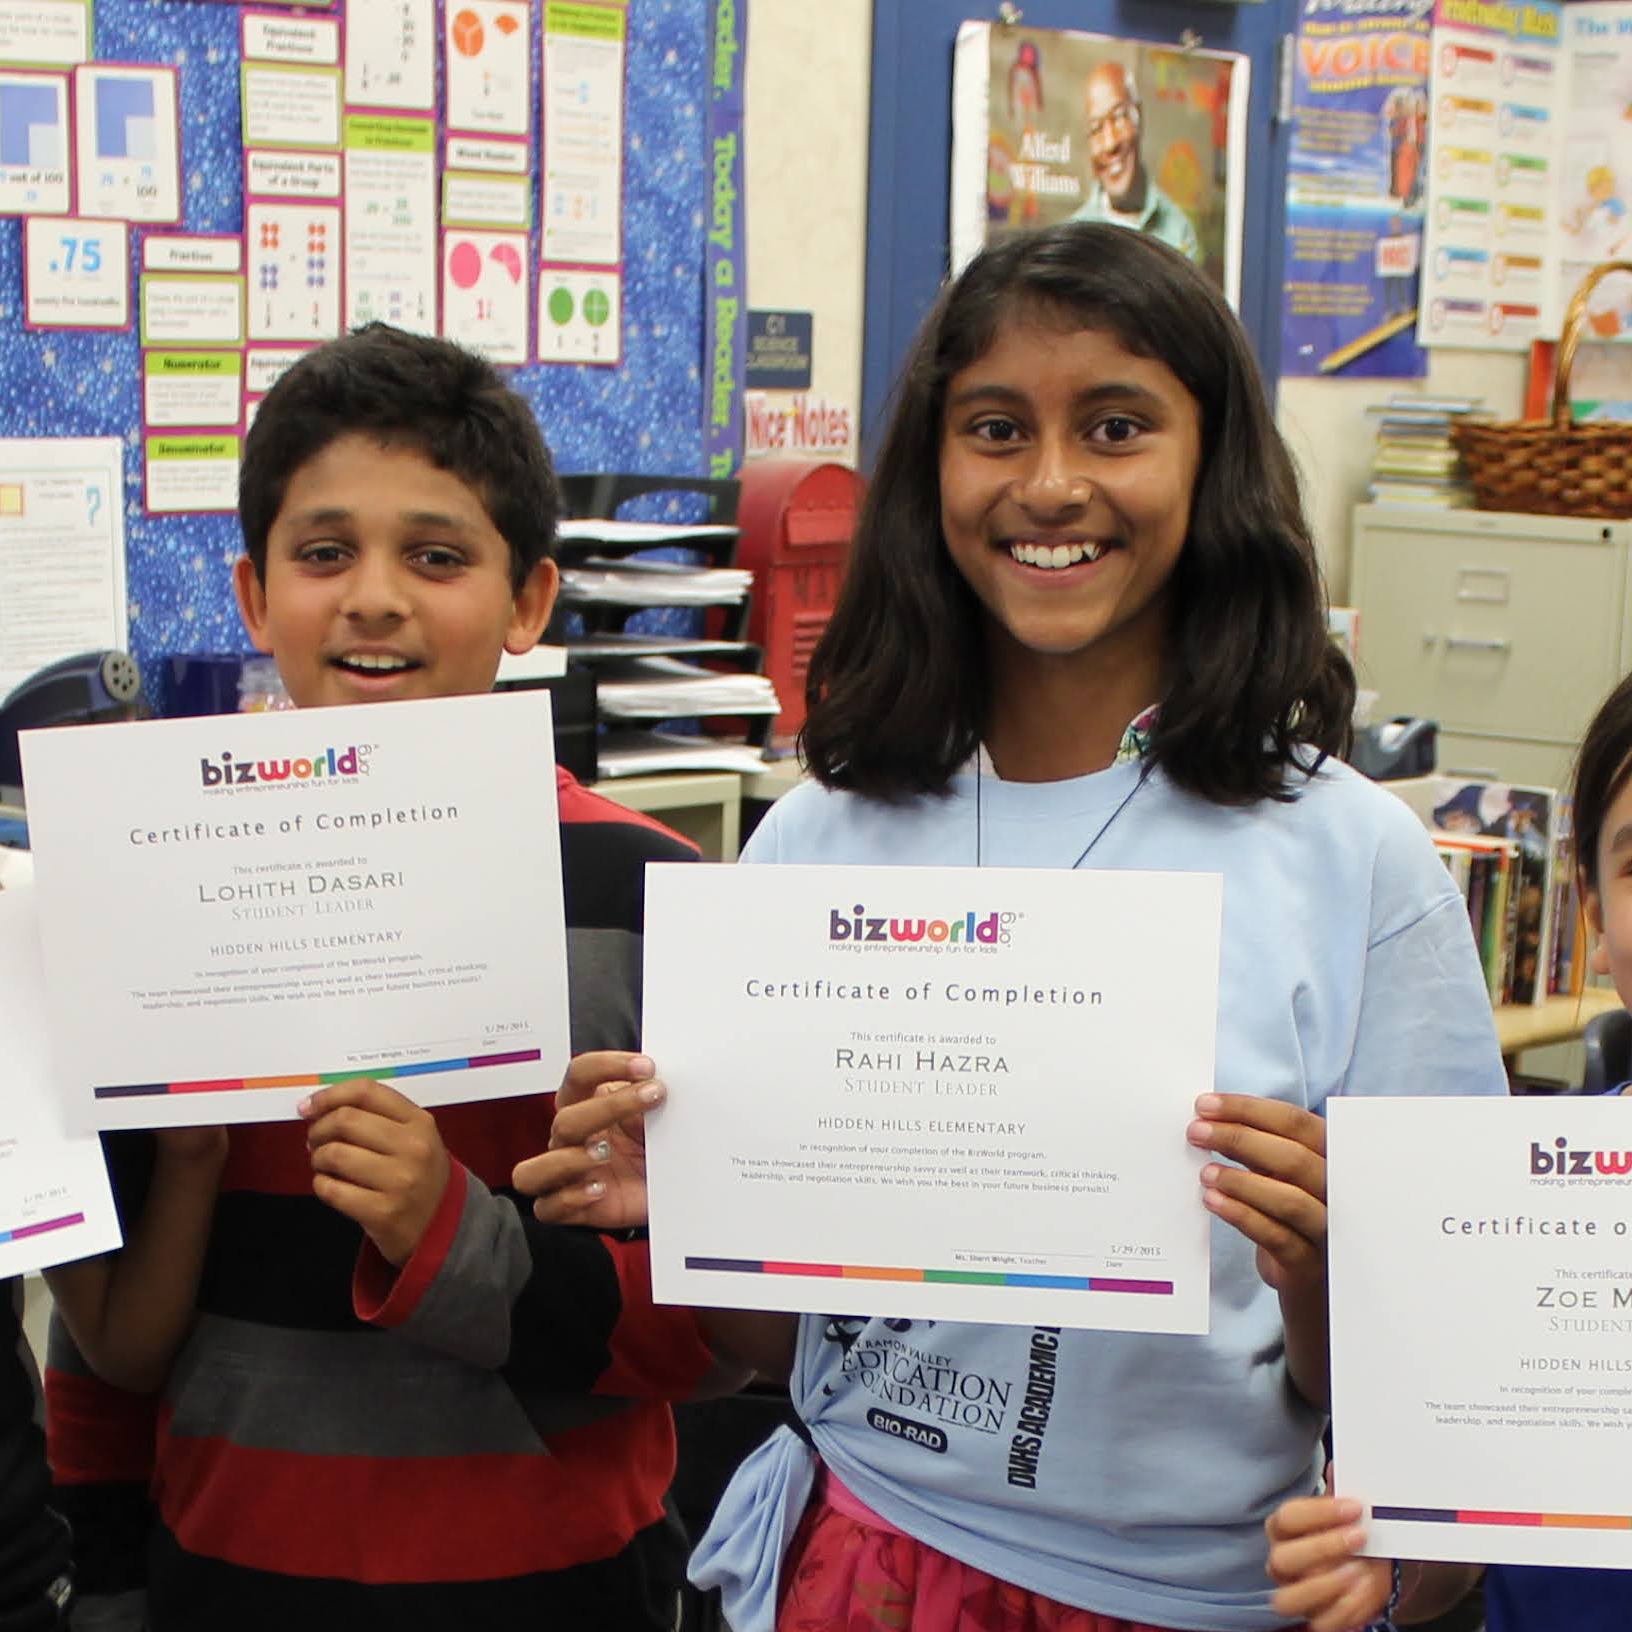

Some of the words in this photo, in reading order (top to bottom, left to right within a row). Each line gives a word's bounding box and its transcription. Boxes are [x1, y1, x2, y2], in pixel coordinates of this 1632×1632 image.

[709, 133, 736, 249] Today
[48, 236, 102, 274] .75
[715, 260, 733, 287] a
[711, 296, 738, 437] Reader.
[750, 399, 785, 448] Nice
[793, 395, 848, 447] Notes
[201, 747, 357, 786] bizworld
[130, 823, 264, 845] Certificate
[280, 815, 302, 833] of
[316, 806, 457, 829] Completion
[199, 880, 295, 902] LOHITH
[308, 872, 403, 894] DASARI
[830, 904, 998, 943] bizworld
[210, 944, 263, 956] HIDDEN
[270, 939, 307, 952] HILLS
[314, 930, 402, 948] ELEMENTARY
[829, 943, 861, 954] making
[946, 944, 961, 954] fun
[963, 944, 978, 954] for
[747, 980, 889, 999] Certificate
[906, 983, 931, 1000] of
[946, 984, 1101, 1006] Completion
[851, 1032, 871, 1041] This
[875, 1032, 924, 1043] certificate
[928, 1034, 936, 1043] is
[939, 1035, 982, 1044] awarded
[986, 1036, 996, 1045] to
[836, 1049, 901, 1070] RAHI
[917, 1051, 1008, 1072] HAZRA
[819, 1117, 873, 1130] HIDDEN
[882, 1120, 921, 1131] HILLS
[929, 1121, 1025, 1134] ELEMENTARY
[1442, 1216, 1596, 1235] Certificate
[1537, 1287, 1597, 1308] ZOE
[1521, 1358, 1581, 1370] HIDDEN
[1589, 1360, 1631, 1371] HILLS
[1018, 1331, 1060, 1433] ACADEMIC
[1007, 1434, 1042, 1489] DVHS
